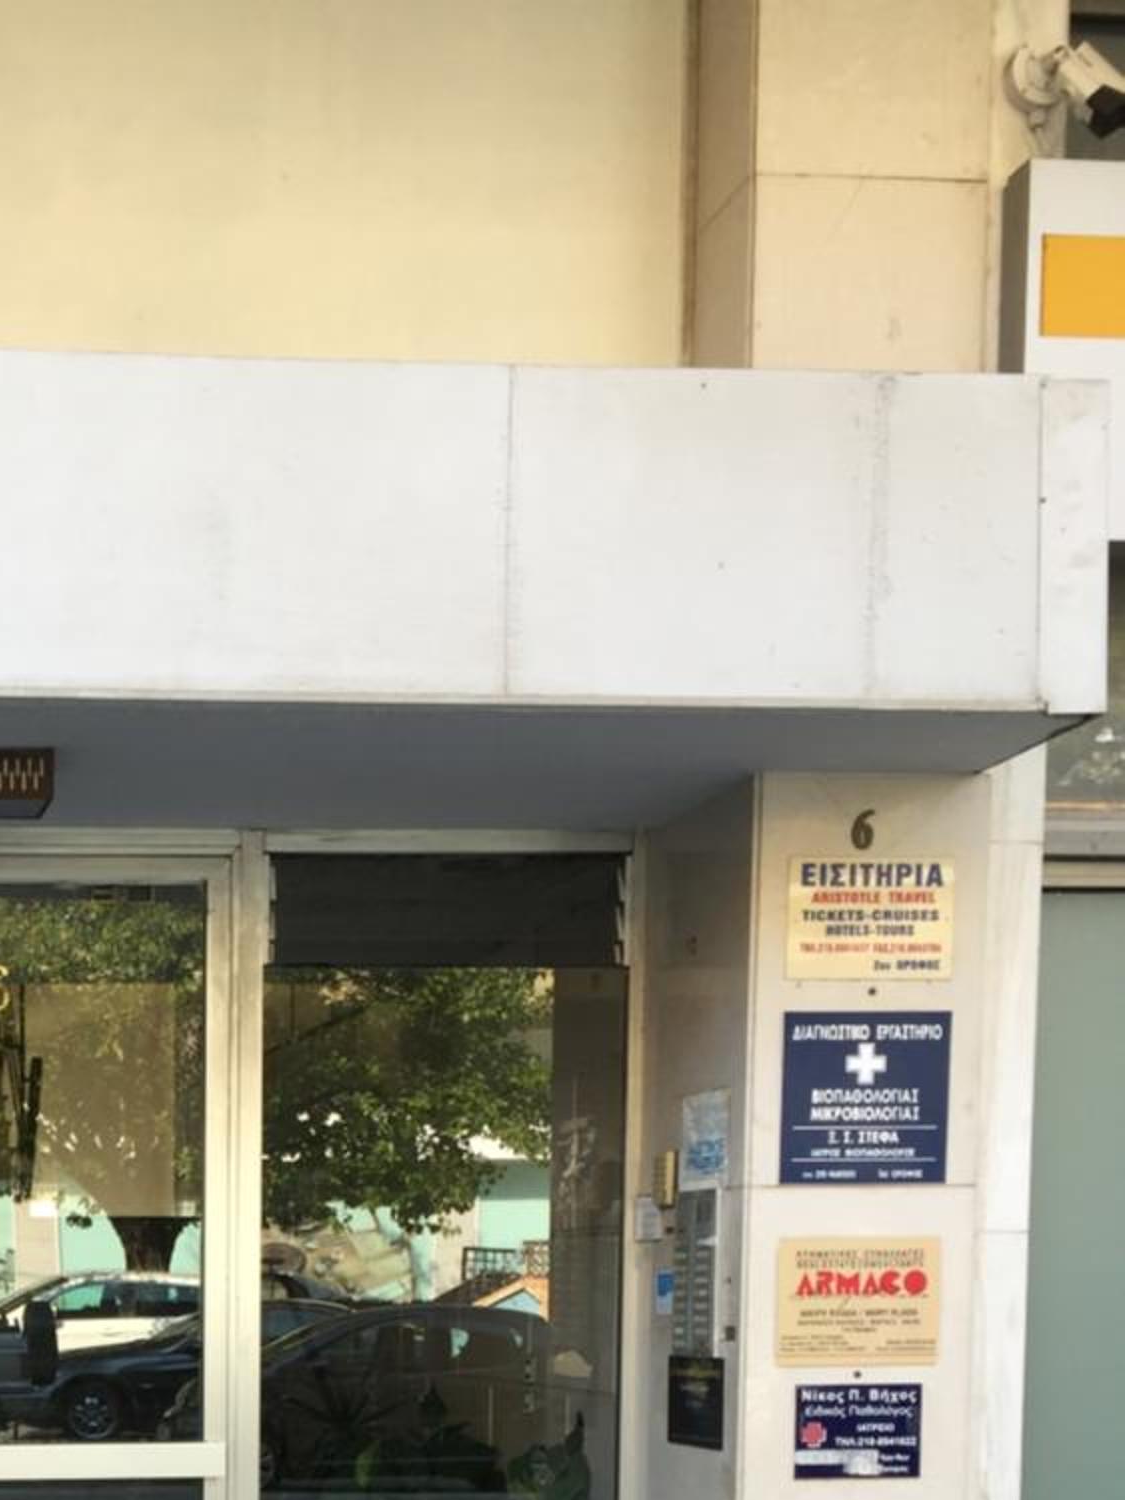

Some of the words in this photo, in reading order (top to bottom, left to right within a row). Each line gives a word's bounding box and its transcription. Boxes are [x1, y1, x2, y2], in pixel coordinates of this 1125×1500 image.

[850, 809, 875, 850] 6
[801, 863, 944, 887] ΕΙΣΙΤΗΡΙΑ
[889, 891, 935, 904] TRAVEL
[876, 1023, 944, 1040] ΕΡΓΑΣΤΗΡΙΟ
[795, 1270, 927, 1296] ARMACO
